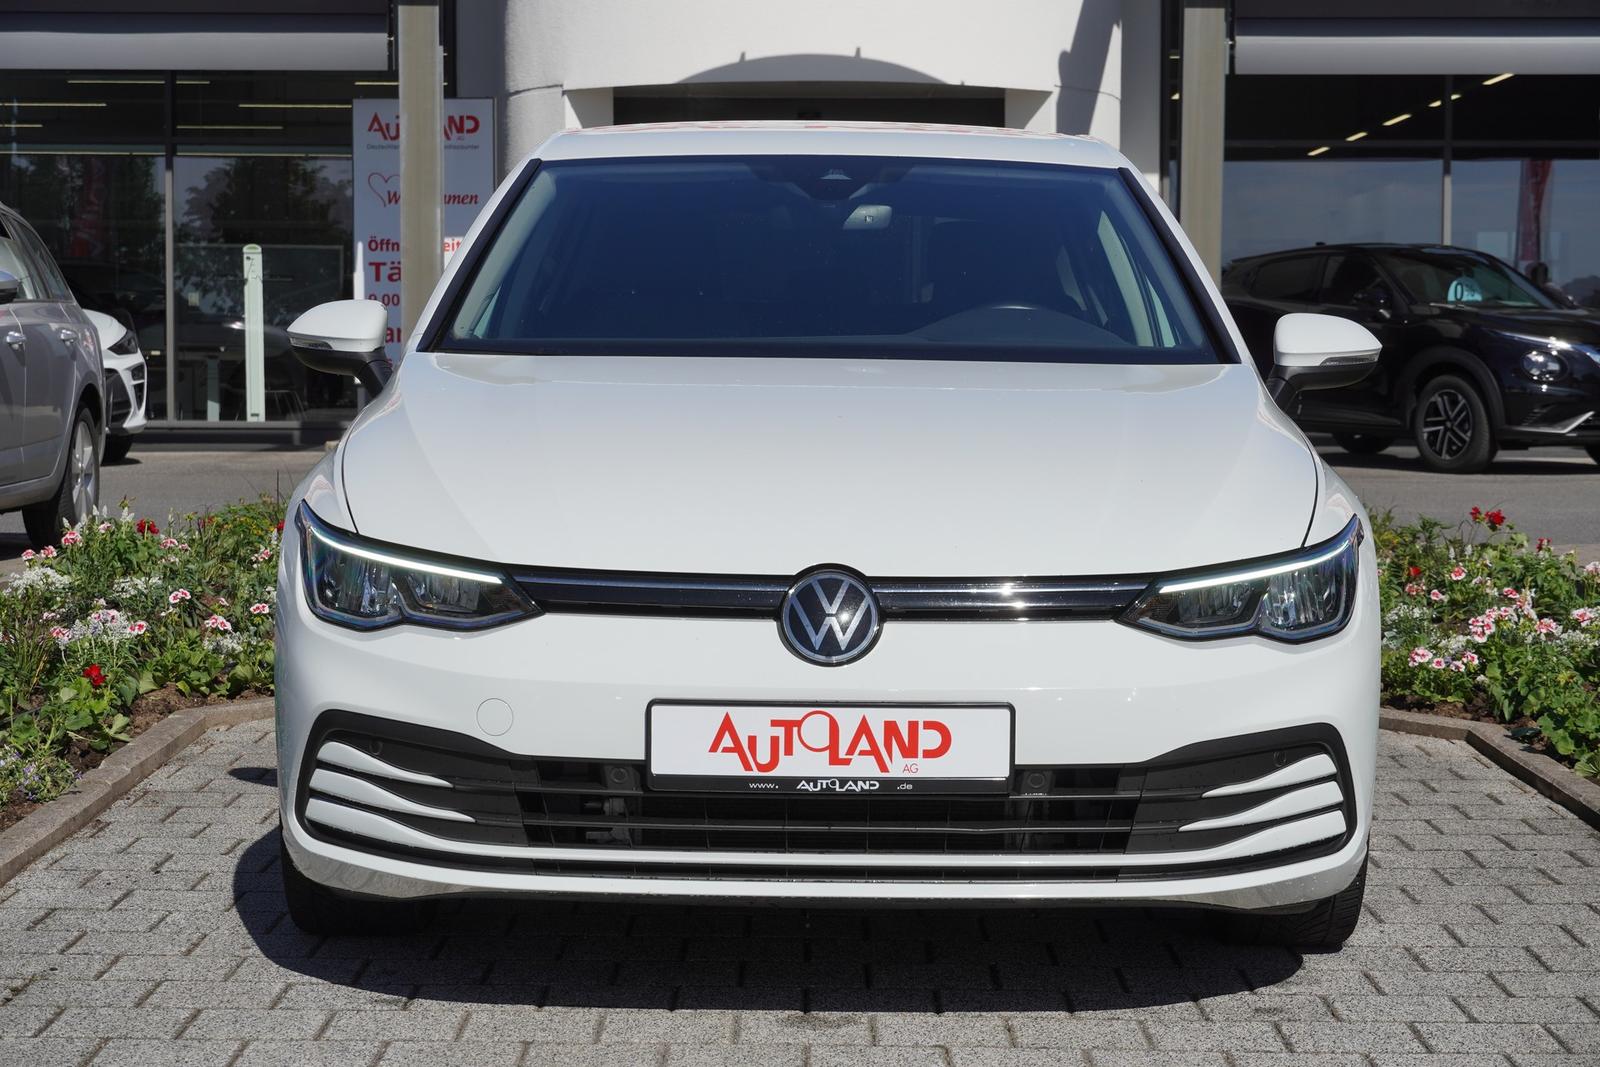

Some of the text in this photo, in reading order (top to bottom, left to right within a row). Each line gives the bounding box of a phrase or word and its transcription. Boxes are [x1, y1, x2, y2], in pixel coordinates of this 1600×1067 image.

[708, 710, 952, 773] AUTOLAND
[902, 763, 919, 774] AG
[796, 778, 880, 792] AUTOLAND
[897, 782, 913, 790] .de
